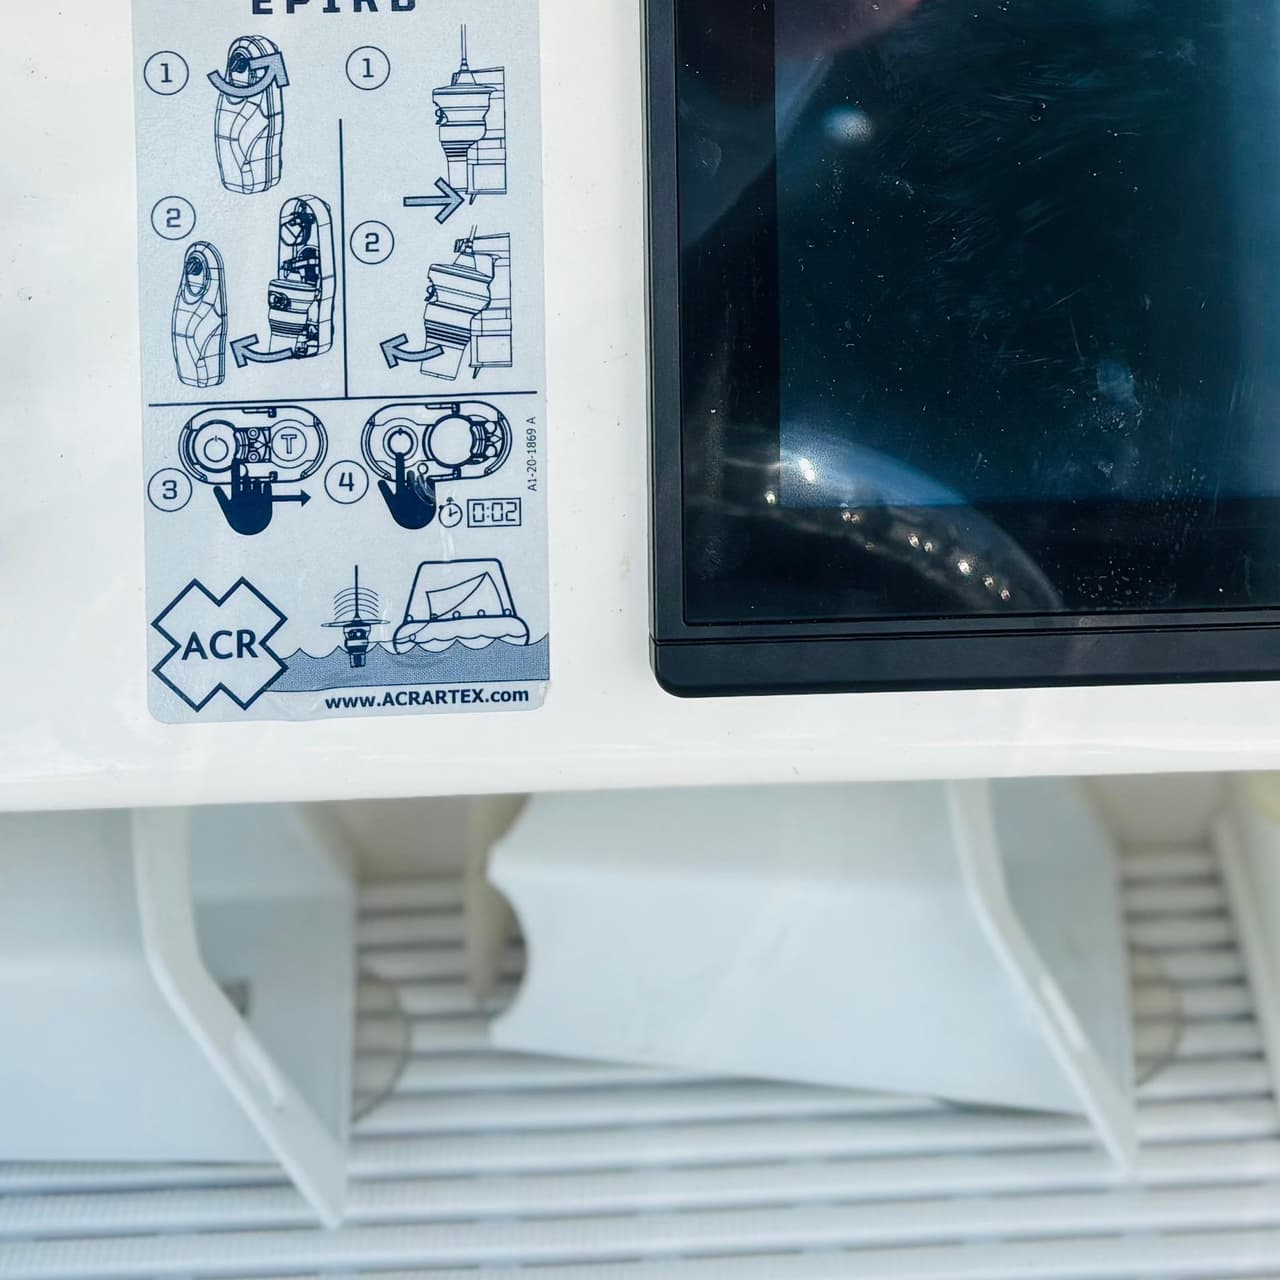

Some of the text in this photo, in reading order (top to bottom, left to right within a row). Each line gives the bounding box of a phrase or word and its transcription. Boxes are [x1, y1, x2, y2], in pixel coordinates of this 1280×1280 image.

[160, 62, 173, 83] 1
[362, 58, 375, 78] 1
[166, 207, 182, 228] 2
[364, 232, 381, 252] 2
[526, 416, 537, 492] A1-20-1869 A
[162, 479, 178, 500] 3
[338, 472, 355, 492] 4
[472, 502, 518, 523] 0:02
[181, 629, 259, 661] ACR
[325, 687, 529, 710] www.ACRARTEX.com
